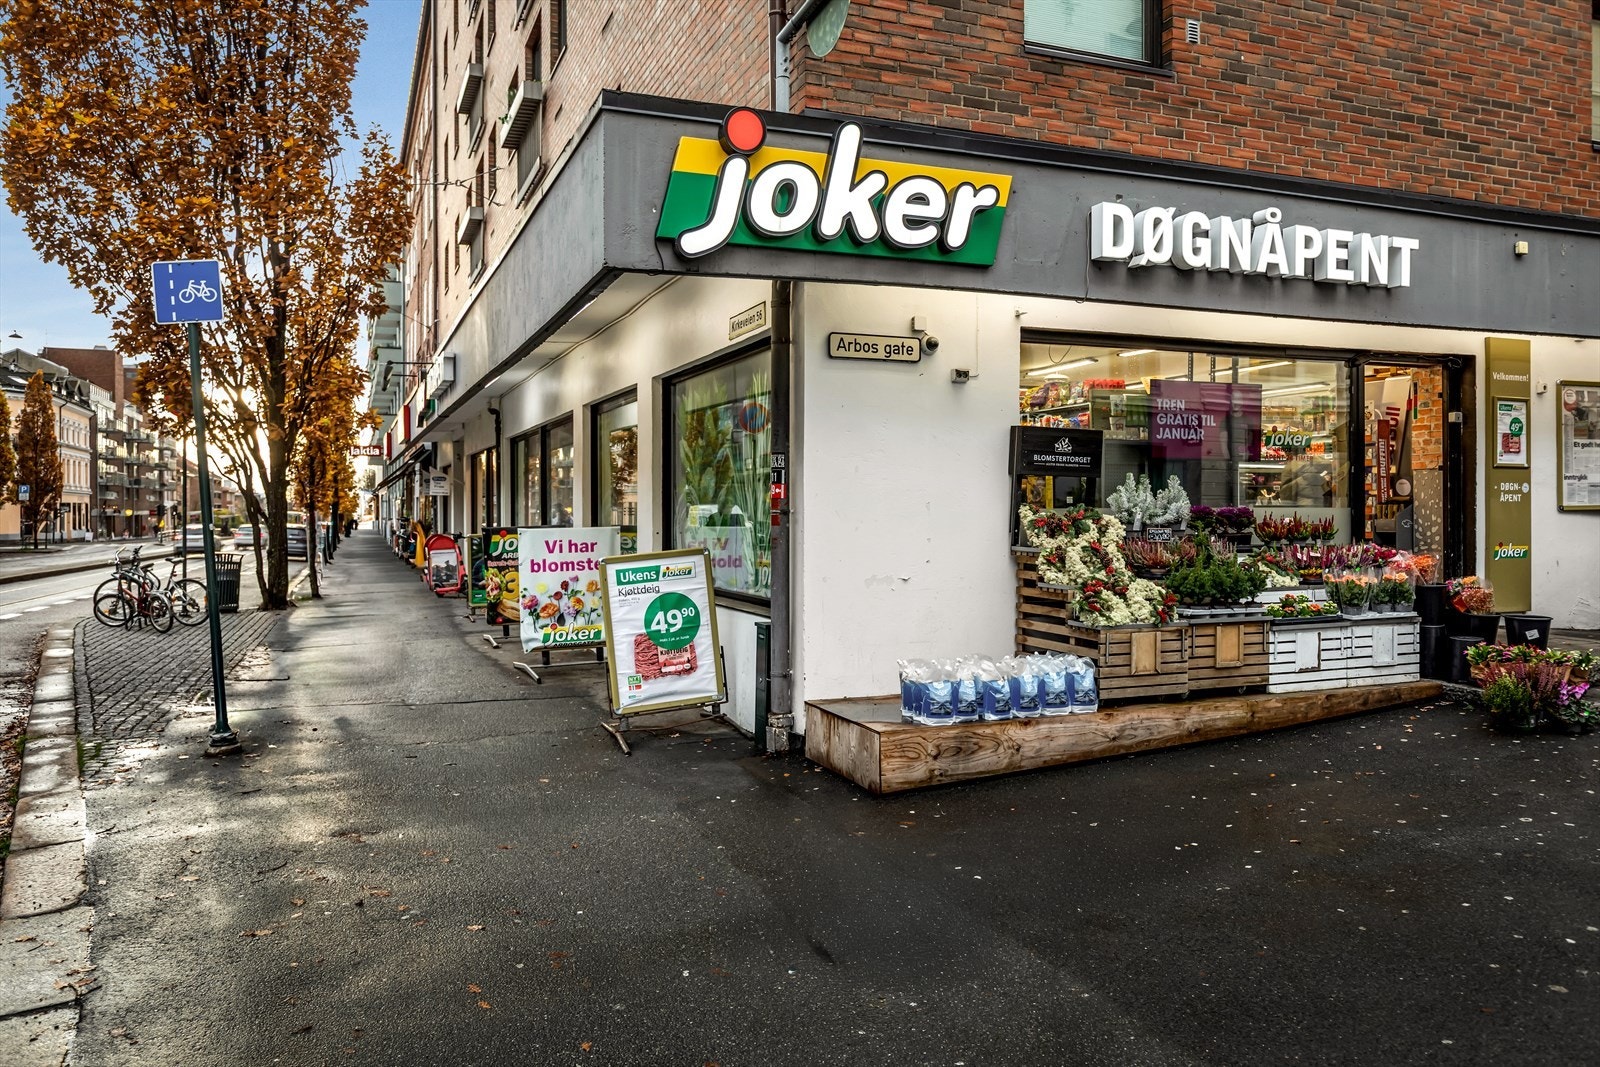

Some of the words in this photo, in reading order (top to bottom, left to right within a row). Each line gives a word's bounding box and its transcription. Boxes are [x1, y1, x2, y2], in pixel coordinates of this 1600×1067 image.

[675, 106, 1000, 259] joker
[1091, 201, 1420, 288] DØGNÅPENT
[731, 314, 756, 333] Kirkeveien
[756, 309, 763, 322] 56
[836, 337, 879, 354] Arbos
[884, 341, 914, 358] gate
[1492, 371, 1529, 382] Velkommen!
[1156, 399, 1185, 411] TREN
[1156, 413, 1199, 427] GRATIS
[1201, 414, 1216, 427] TIL
[1156, 427, 1205, 441] JANUAR
[1266, 425, 1310, 449] joker
[1033, 454, 1091, 465] BLOMSTERTORGET
[1499, 492, 1522, 502] ÅPENT
[544, 539, 563, 554] Vi
[567, 538, 598, 553] har
[1494, 542, 1527, 561] joker
[620, 570, 657, 583] Ukens
[662, 566, 691, 579] joker
[618, 585, 660, 598] Kjøttdeig
[543, 622, 598, 645] joker
